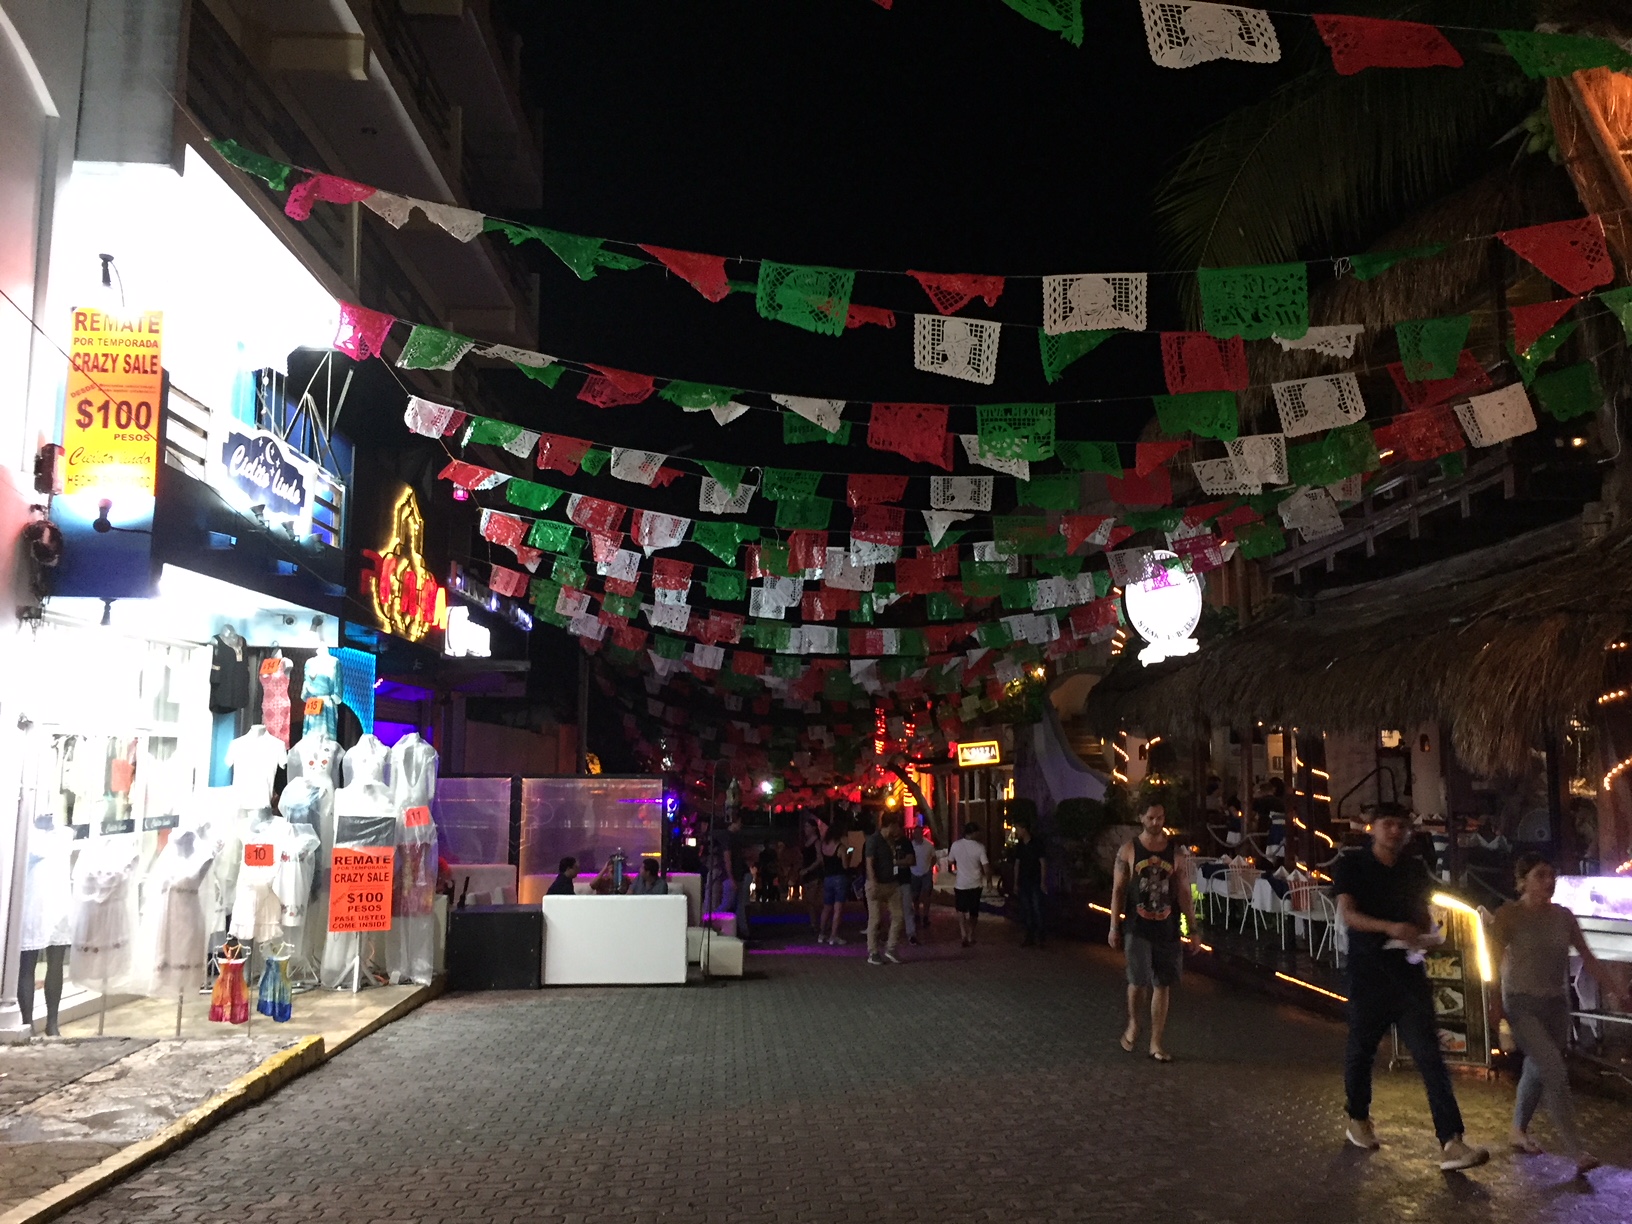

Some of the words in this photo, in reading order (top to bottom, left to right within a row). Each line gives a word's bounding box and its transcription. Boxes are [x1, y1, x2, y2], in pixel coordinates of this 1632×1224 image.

[74, 311, 160, 334] REMATE
[73, 337, 94, 346] POR
[97, 337, 159, 348] TEMPORADA
[72, 352, 119, 373] CRAZY
[123, 353, 158, 375] SALE
[70, 382, 96, 398] DESDE
[75, 397, 152, 432] $100
[114, 433, 150, 442] PESOS
[334, 855, 391, 866] REMATE
[334, 873, 364, 884] CRAZY
[367, 872, 390, 882] SALE
[347, 892, 384, 903] $100
[347, 904, 382, 913] PESOS
